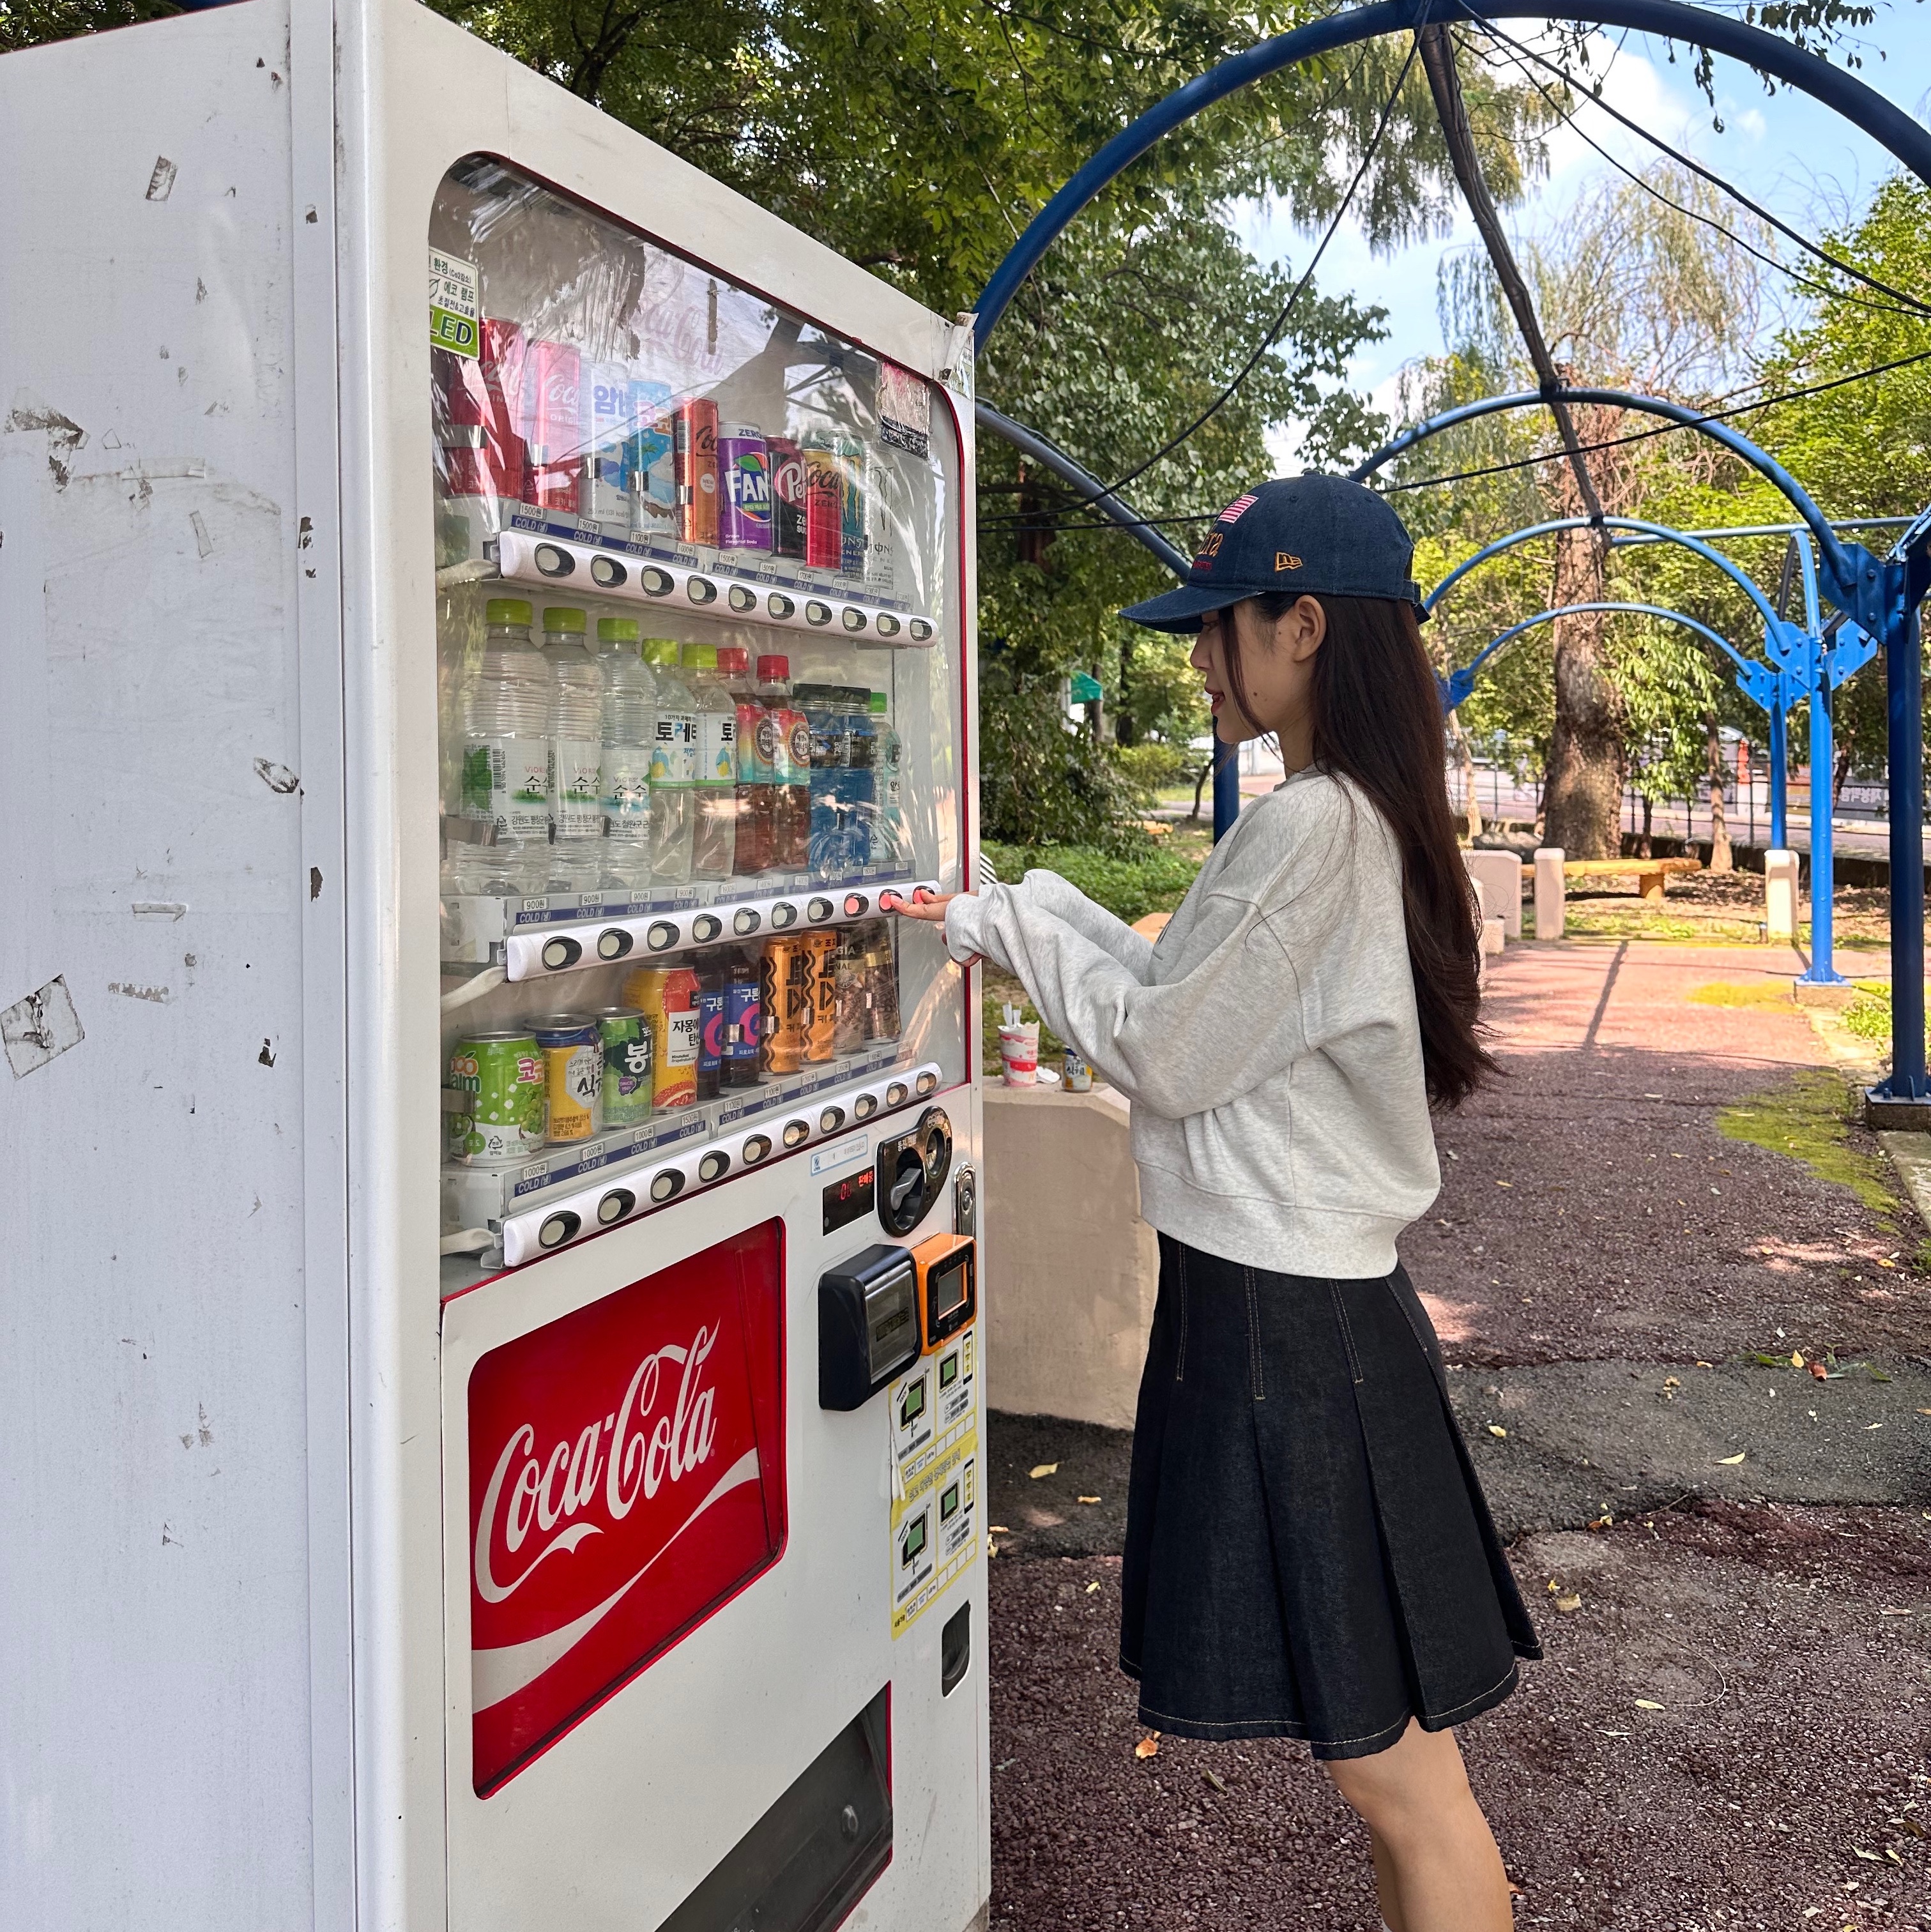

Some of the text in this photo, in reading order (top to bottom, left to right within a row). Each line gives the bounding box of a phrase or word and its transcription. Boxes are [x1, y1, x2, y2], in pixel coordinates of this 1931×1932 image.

[444, 281, 475, 303] 에코 램프
[738, 428, 763, 439] ZERO
[521, 505, 542, 518] 1500원
[515, 517, 537, 531] COLD
[579, 520, 598, 533] 1500원
[574, 531, 593, 544] COLD
[632, 533, 649, 544] 1100원
[625, 543, 643, 555] COLD
[673, 554, 688, 565] COLD
[715, 564, 730, 575] COLD
[756, 573, 770, 582] COLD
[793, 581, 807, 591] COLD
[830, 588, 843, 597] COLD
[572, 776, 600, 795] 순수
[613, 784, 647, 800] 순수
[511, 814, 530, 825] 강원도
[622, 819, 643, 829] 철원군
[583, 894, 600, 904] 900원
[634, 892, 648, 901] 900원
[526, 900, 545, 909] 900원
[627, 903, 644, 914] COLD
[673, 901, 689, 910] COLD
[520, 912, 540, 924] COLD
[576, 907, 595, 918] COLD
[740, 988, 761, 1003] 구론
[625, 1040, 653, 1074] 봉
[834, 1074, 846, 1083] COLD
[800, 1085, 813, 1095] COLD
[763, 1099, 776, 1109] COLD
[682, 1113, 698, 1124] 1500원
[722, 1111, 737, 1123] COLD
[635, 1128, 652, 1141] 1000원
[679, 1125, 695, 1137] COLD
[584, 1145, 602, 1159] 1000원
[631, 1142, 648, 1155] COLD
[524, 1165, 546, 1178] 1000원
[578, 1159, 597, 1173] COLD
[518, 1178, 540, 1194] COLD
[475, 1317, 721, 1604] Coca-Cola
